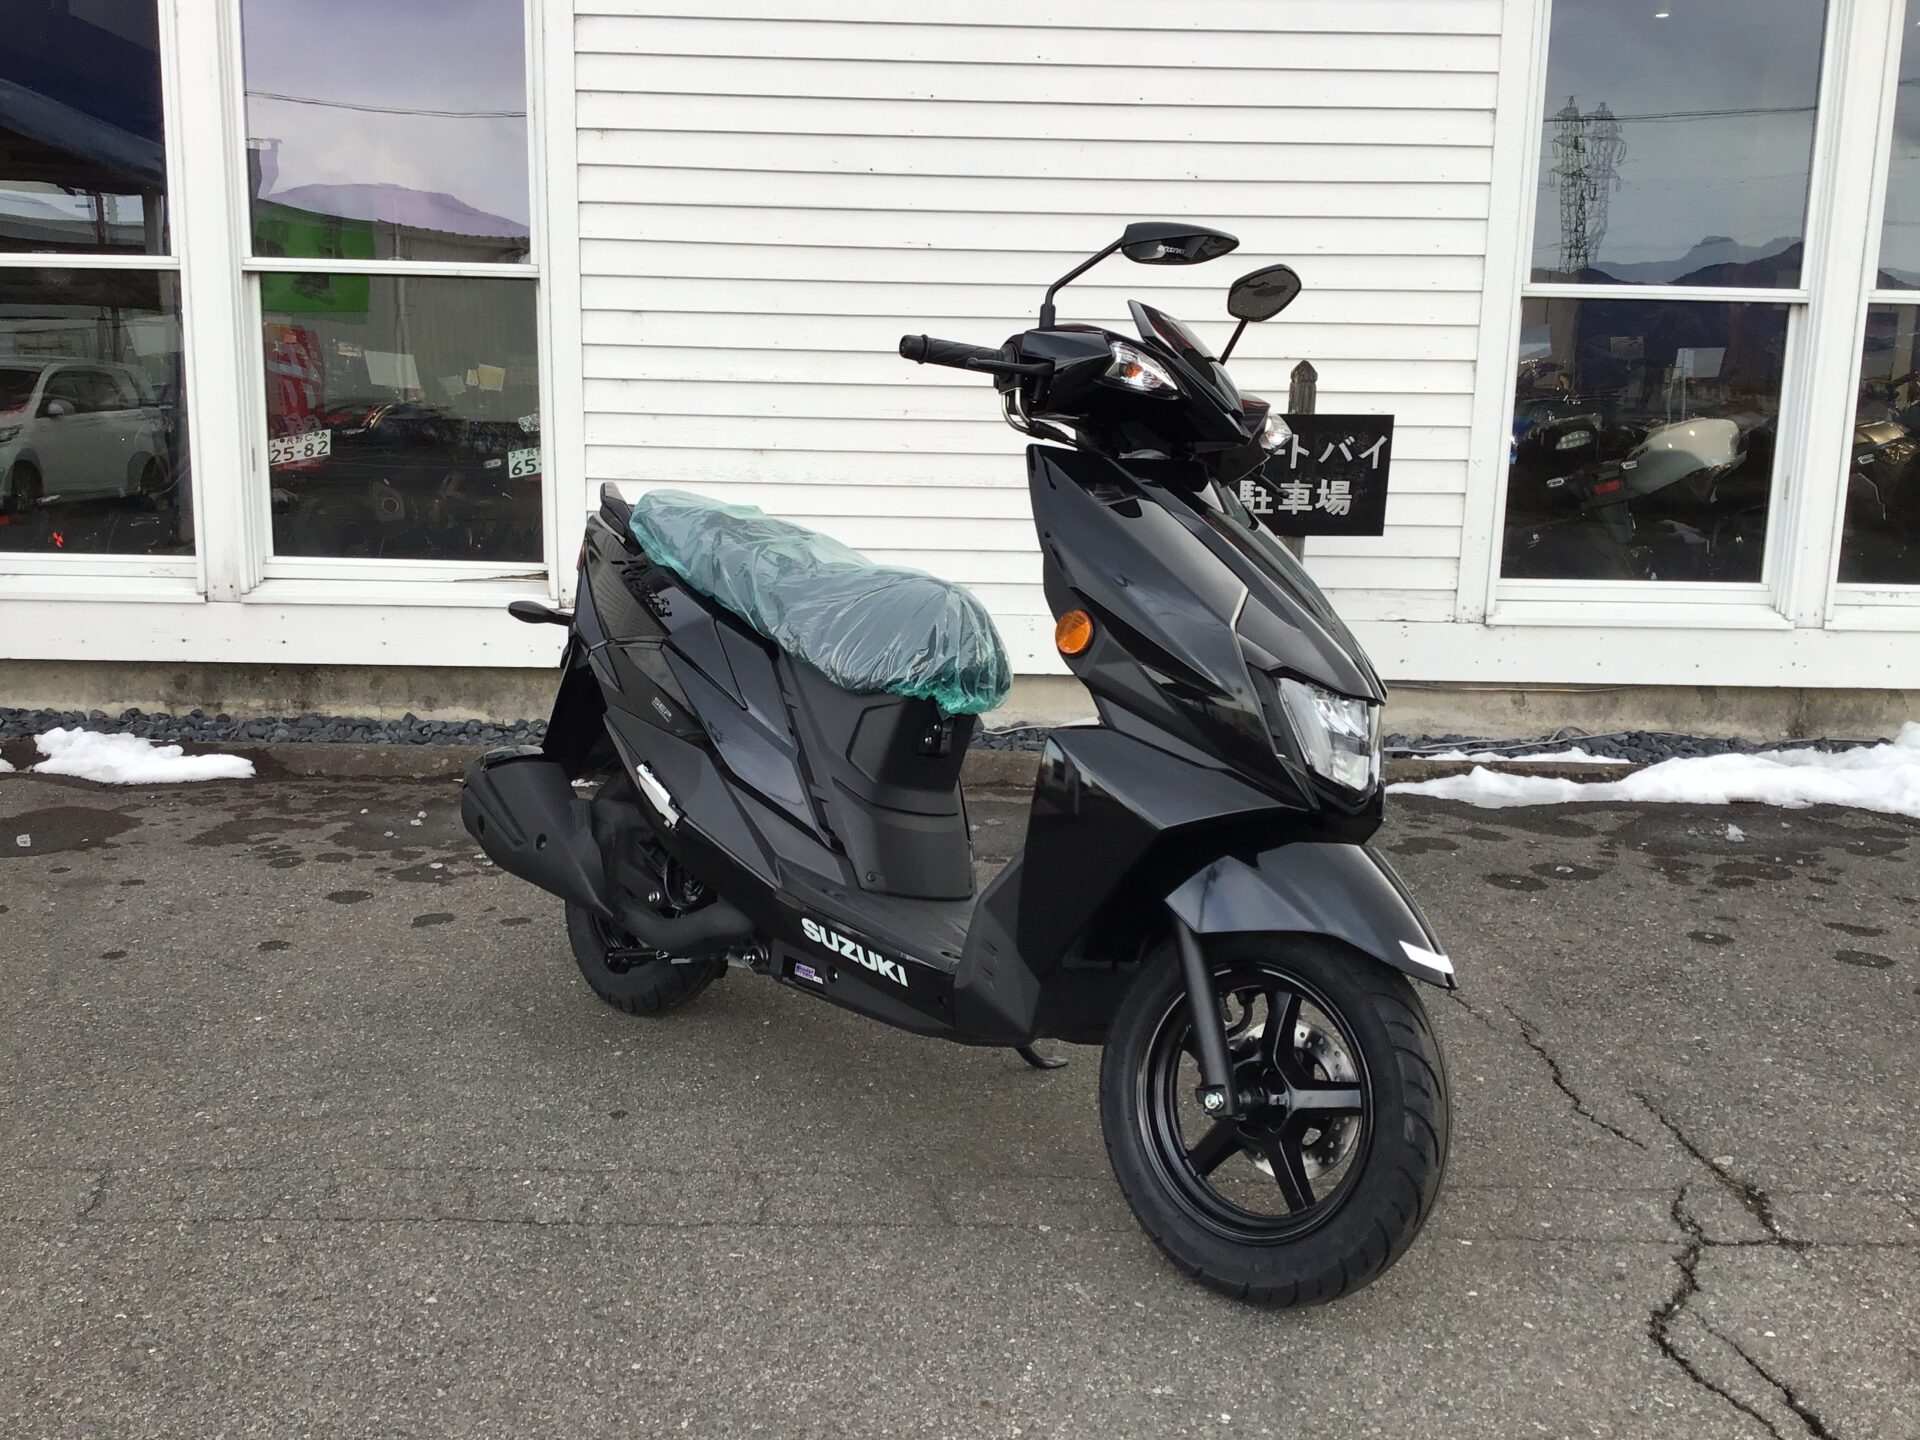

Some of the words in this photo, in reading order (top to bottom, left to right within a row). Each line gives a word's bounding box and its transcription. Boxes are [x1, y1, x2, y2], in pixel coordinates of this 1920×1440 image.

[270, 440, 328, 463] 25-82
[1239, 478, 1352, 516] 駐車場
[801, 917, 909, 988] SUZUKI
